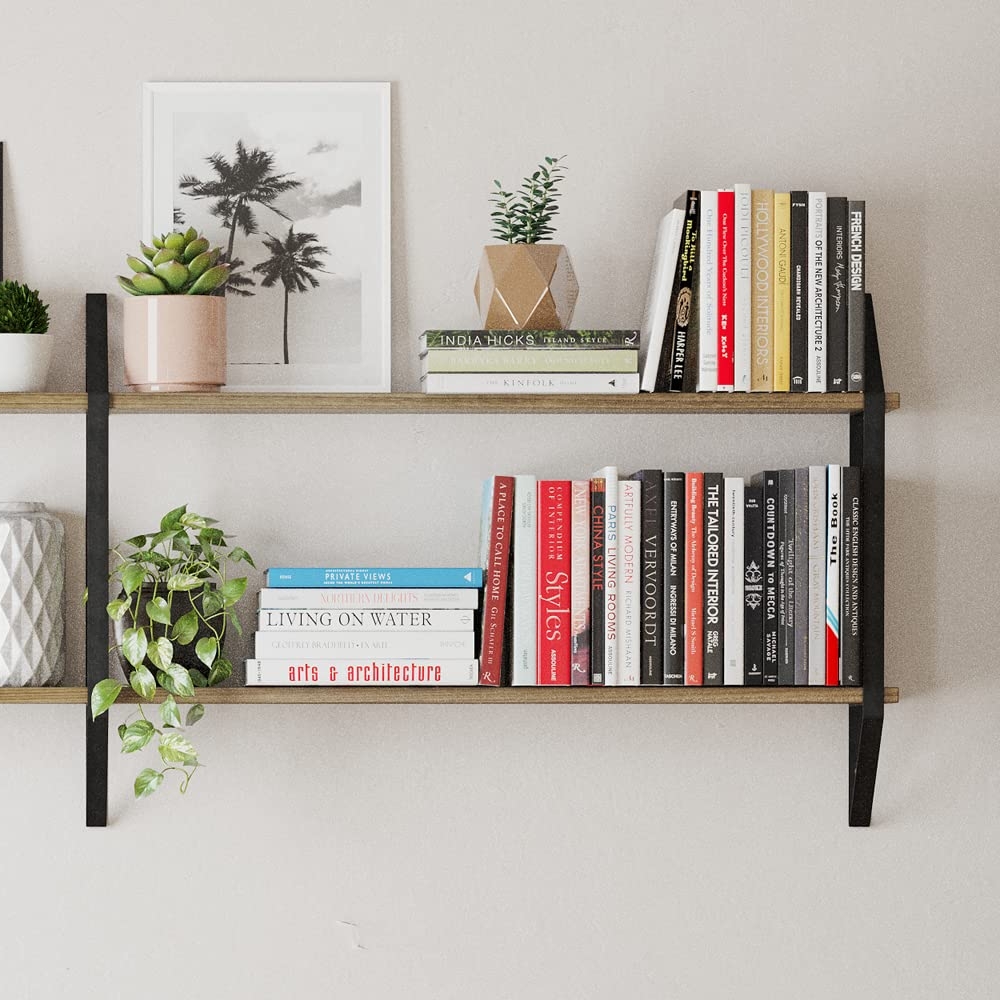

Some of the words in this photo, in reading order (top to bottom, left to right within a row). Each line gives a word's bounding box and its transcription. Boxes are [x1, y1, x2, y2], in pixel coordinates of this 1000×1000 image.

[815, 198, 823, 238] PORTRAITS
[851, 211, 862, 253] FRENCH
[680, 219, 693, 282] Mockingbird
[691, 231, 697, 242] To
[756, 202, 769, 291] HOLLYWOOD
[778, 228, 786, 257] ANTONI
[815, 240, 823, 251] OF
[689, 244, 697, 263] Kill
[815, 252, 823, 266] THE
[815, 268, 823, 285] NEW
[851, 254, 862, 291] DESIGN
[756, 295, 769, 366] INTERIORS
[815, 287, 823, 345] ARCHITECTURE
[440, 335, 482, 345] INDIA
[486, 335, 535, 345] HICKS
[675, 331, 686, 362] HARPER
[503, 379, 555, 387] KINFOLK
[673, 365, 685, 379] LEE
[499, 482, 507, 490] A
[548, 486, 555, 500] OF
[573, 488, 585, 515] NEW
[707, 484, 718, 508] THE
[497, 492, 507, 523] PLACE
[624, 484, 633, 531] ARTFULLY
[645, 480, 657, 527] AXEL
[689, 504, 697, 525] Beauty
[830, 493, 838, 528] Book
[495, 525, 504, 540] TO
[593, 505, 603, 550] CHINA
[607, 505, 616, 541] PARIS
[669, 500, 678, 541] ENTRYWAYS
[767, 497, 775, 568] COUNTDOWN
[573, 520, 585, 553] YORK
[669, 542, 678, 553] OF
[689, 540, 697, 563] Alchemy
[707, 509, 718, 567] TAILORED
[830, 535, 838, 566] The
[493, 542, 503, 567] CALL
[607, 547, 616, 588] LIVING
[624, 535, 633, 584] MODERN
[669, 554, 678, 576] MILAN
[787, 538, 795, 575] Twilight
[325, 573, 362, 581] PRIVATE
[363, 573, 391, 581] VIEWS
[491, 569, 502, 601] HOME
[593, 554, 603, 591] STYLE
[689, 572, 697, 592] Design
[767, 572, 774, 584] TO
[788, 577, 795, 587] of
[320, 593, 369, 602] NORTHERN
[370, 593, 418, 602] DELIGHTS
[538, 571, 570, 641] Styles
[573, 557, 585, 630] APARTMENTS
[645, 535, 657, 647] VERVOORDT
[669, 585, 678, 618] INGRESSI
[707, 569, 718, 624] INTERIOR
[767, 587, 775, 620] MECCA
[266, 612, 332, 626] LIVING
[338, 612, 363, 626] ON
[369, 612, 432, 626] WATER
[607, 593, 616, 640] ROOMS
[624, 590, 632, 627] RICHARD
[787, 600, 795, 627] Literary
[624, 629, 632, 668] MISHAAN
[669, 626, 678, 656] MILANO
[288, 663, 318, 682] arts
[329, 666, 338, 682] &
[347, 663, 441, 682] architecture
